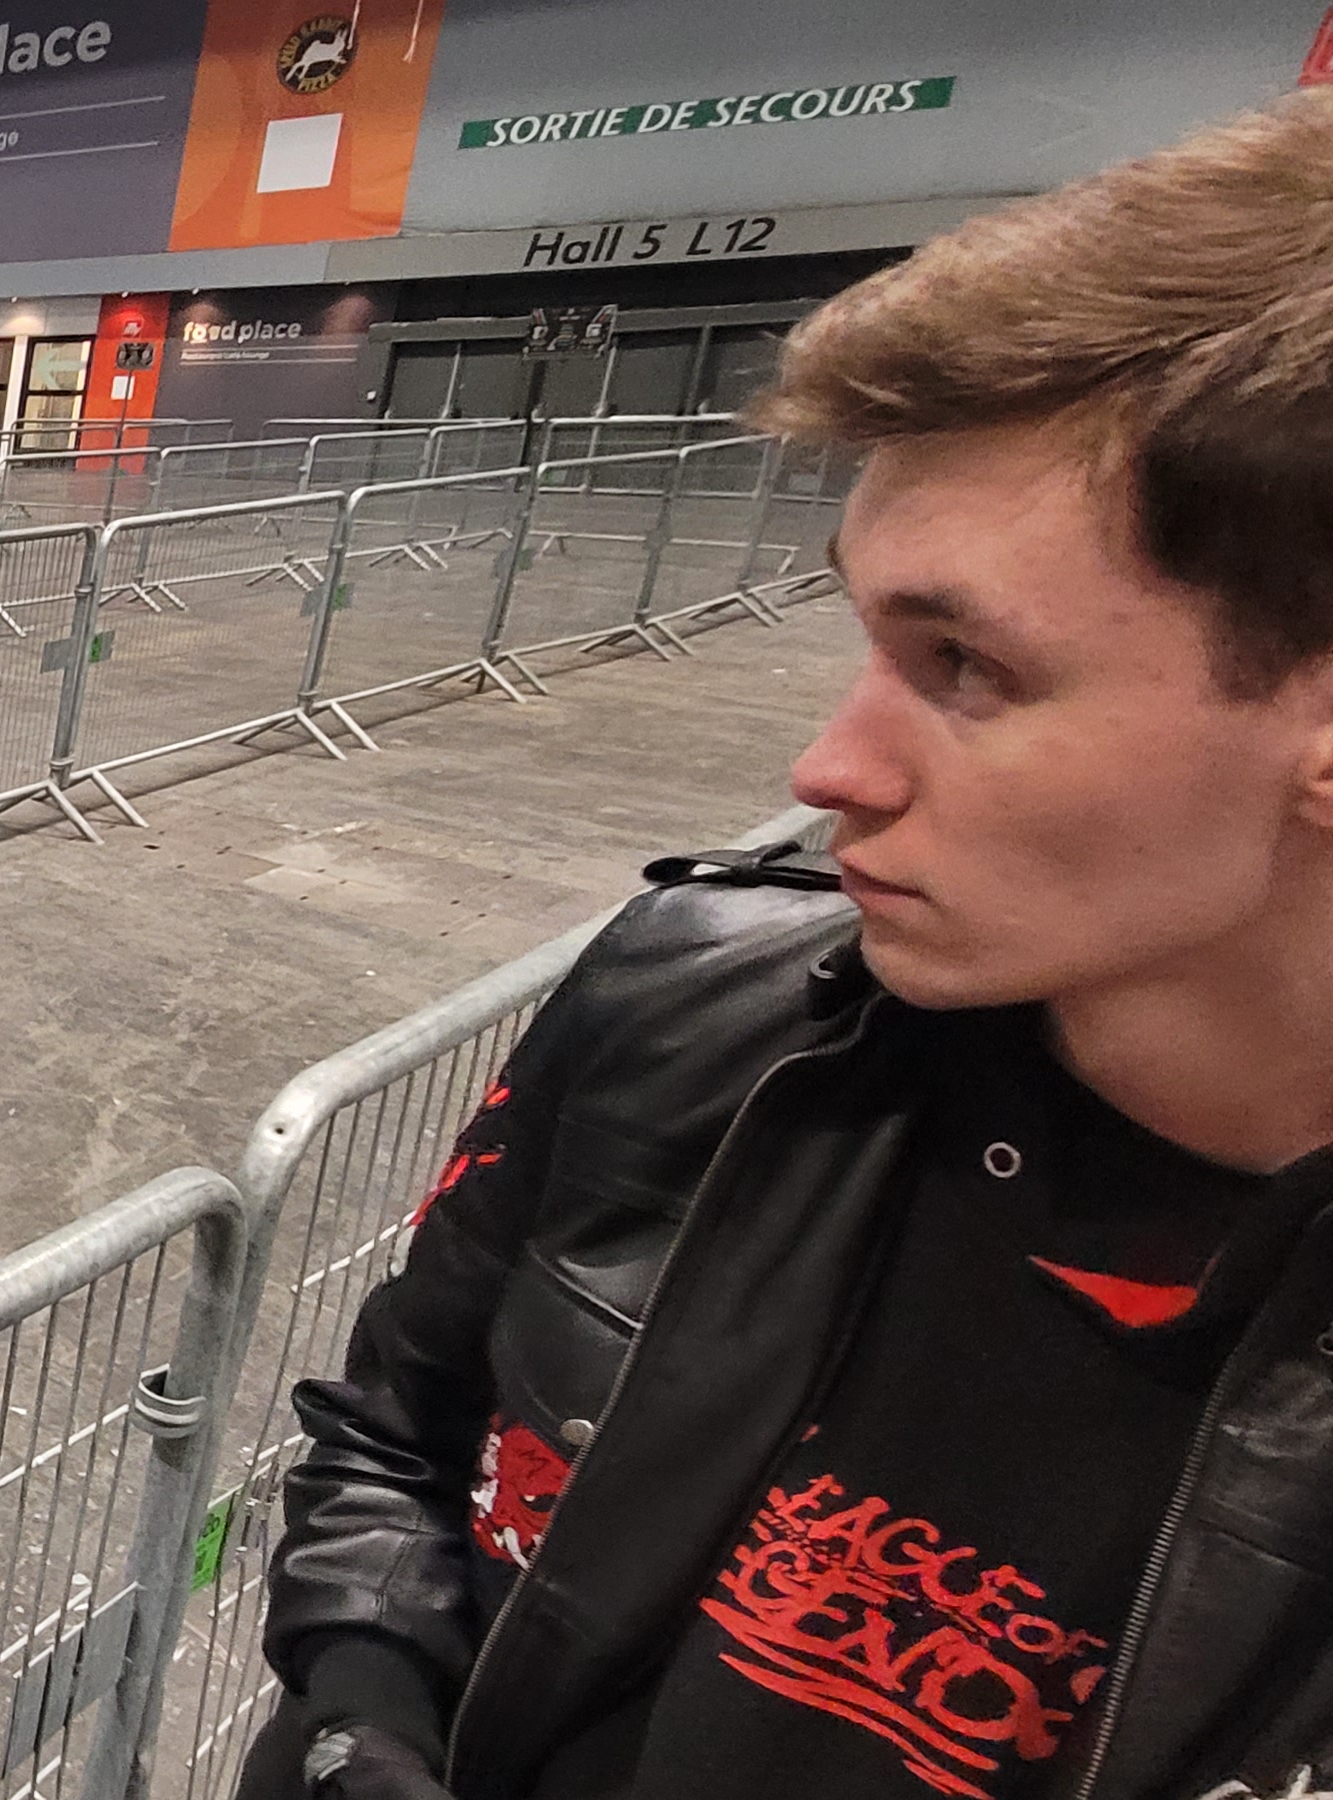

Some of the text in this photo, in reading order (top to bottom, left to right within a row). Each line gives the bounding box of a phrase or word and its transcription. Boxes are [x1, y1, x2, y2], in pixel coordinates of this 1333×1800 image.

[486, 80, 922, 147] SORTIE DE SECOURS
[523, 216, 777, 268] Hall 5 L12
[237, 320, 302, 344] place
[763, 1473, 1046, 1639] EAGUE
